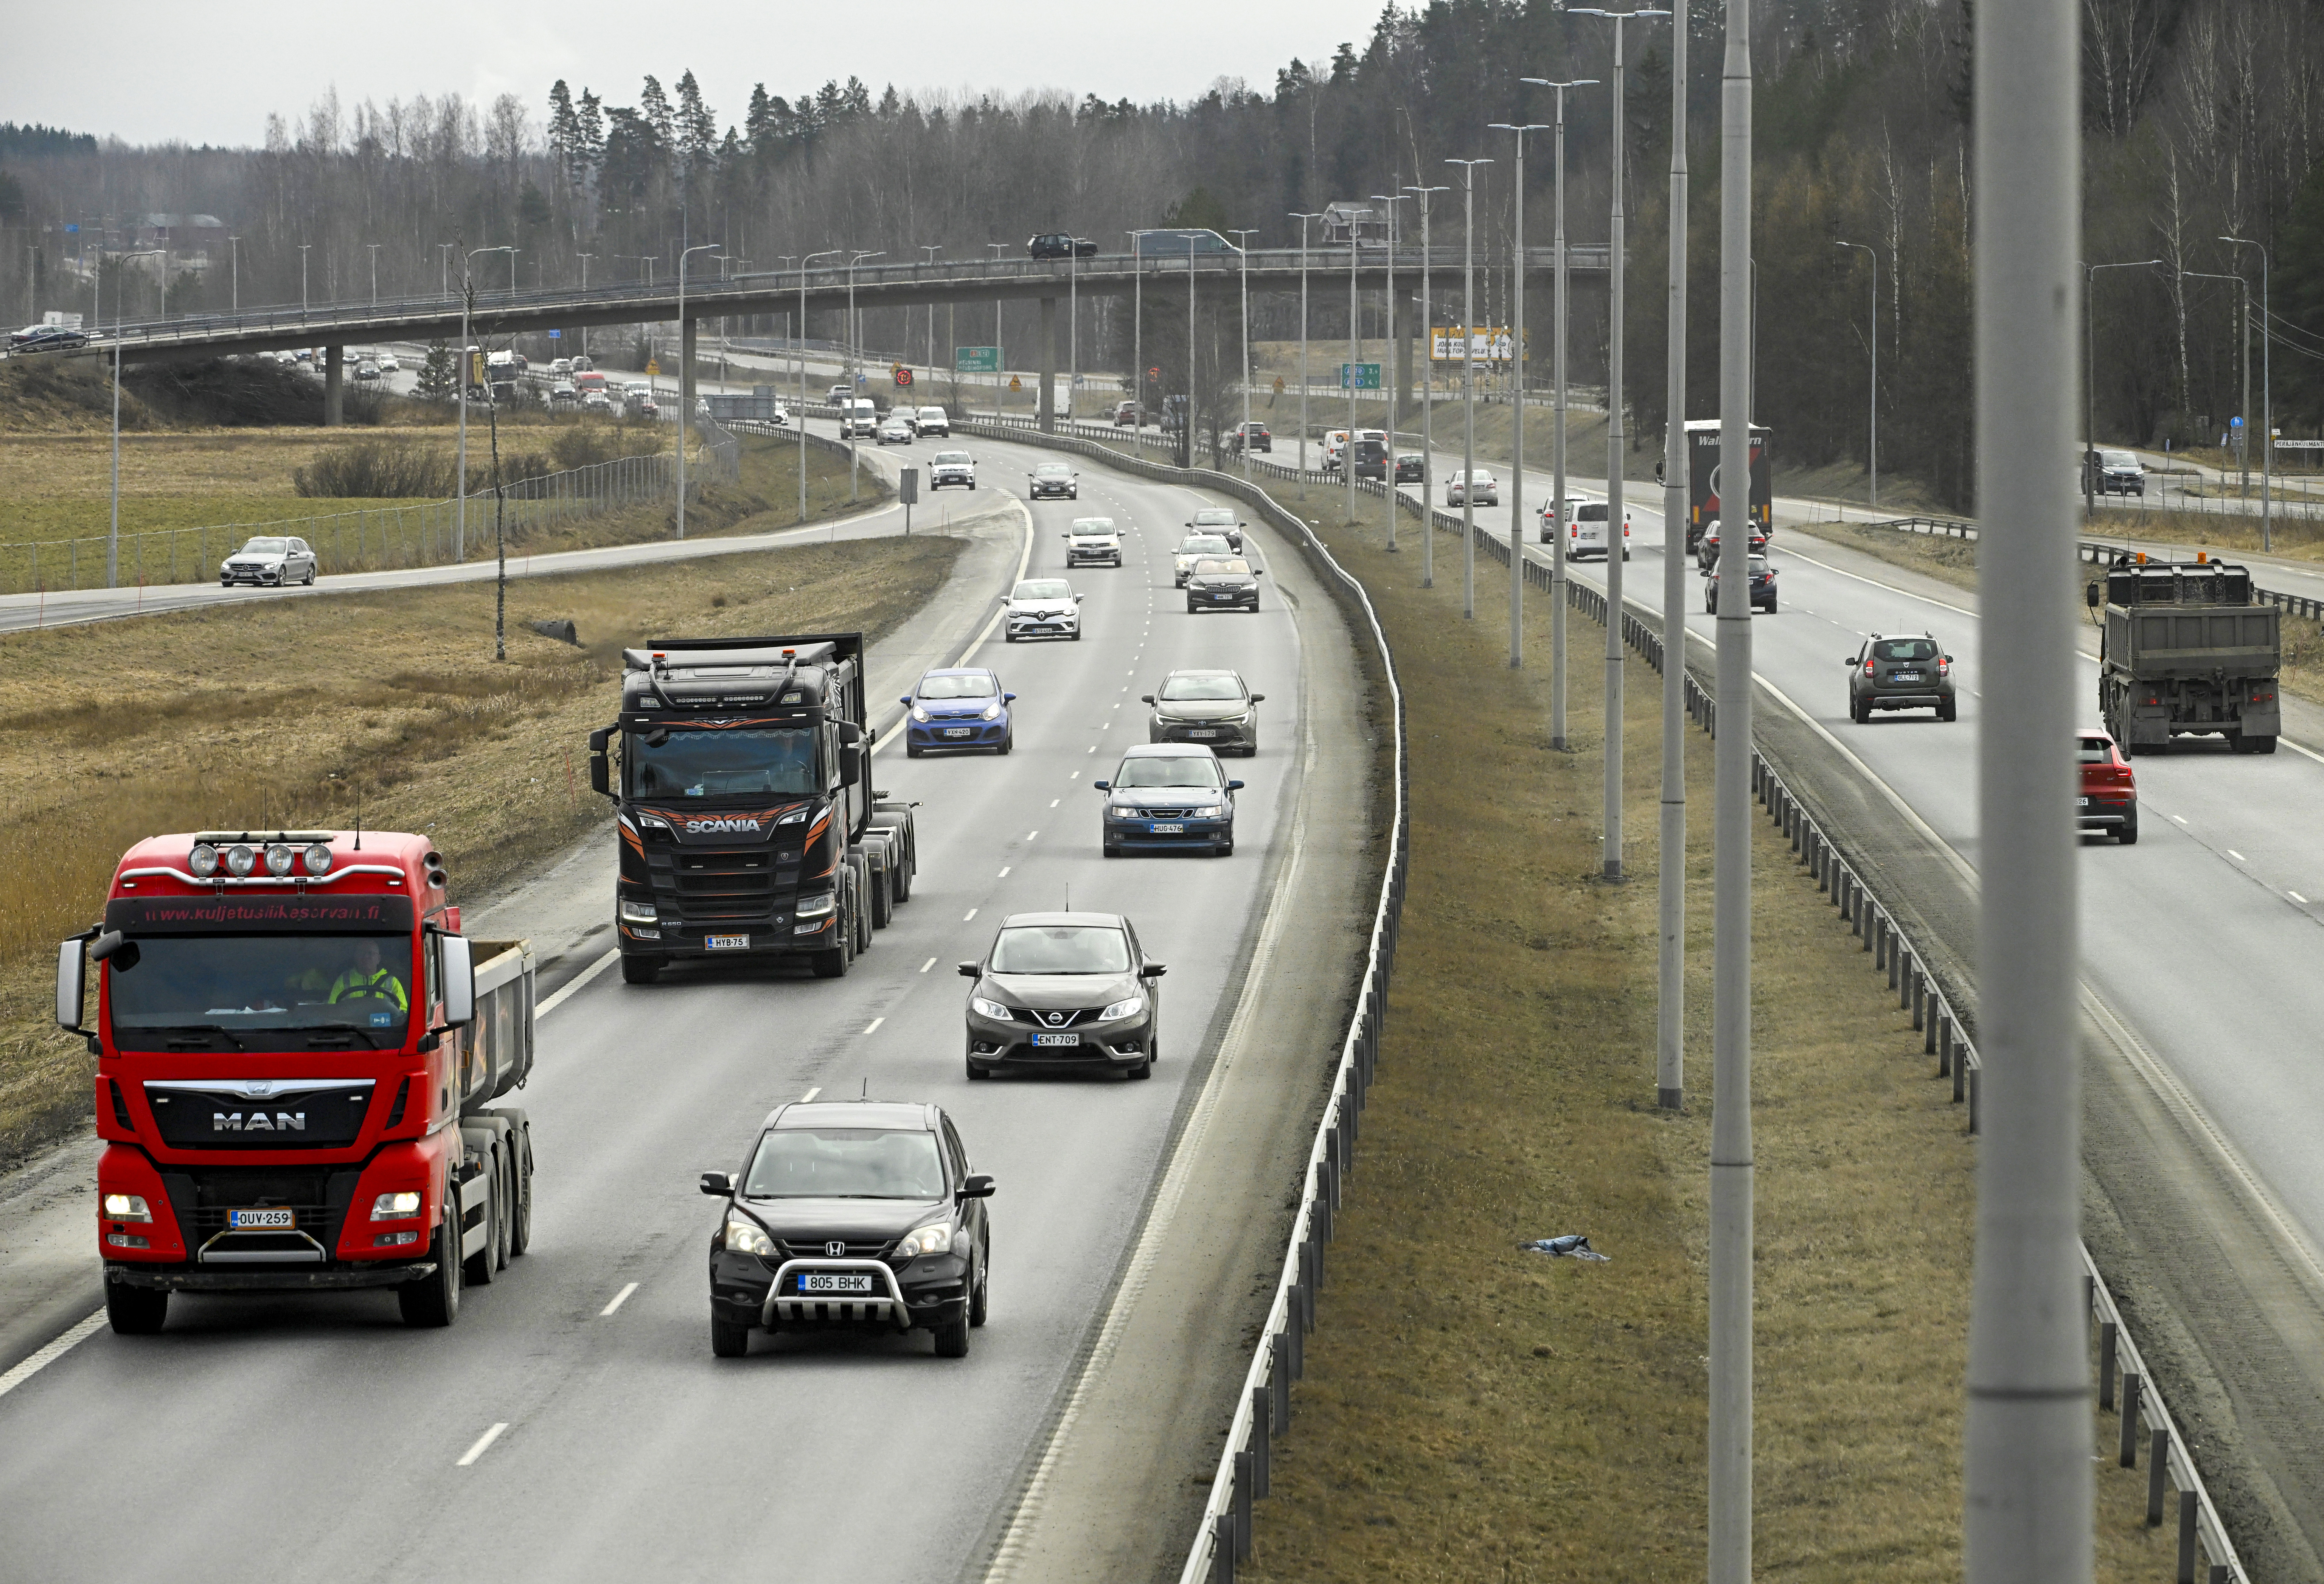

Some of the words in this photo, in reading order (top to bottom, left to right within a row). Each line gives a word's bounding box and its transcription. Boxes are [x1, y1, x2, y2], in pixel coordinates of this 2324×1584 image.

[1699, 436, 1762, 446] Wallrn
[686, 819, 761, 833] SCANIA
[1039, 1036, 1077, 1044] ENT-709
[214, 1113, 305, 1131] MAN
[240, 1213, 289, 1224] OUV-259
[838, 1277, 865, 1289] BHK
